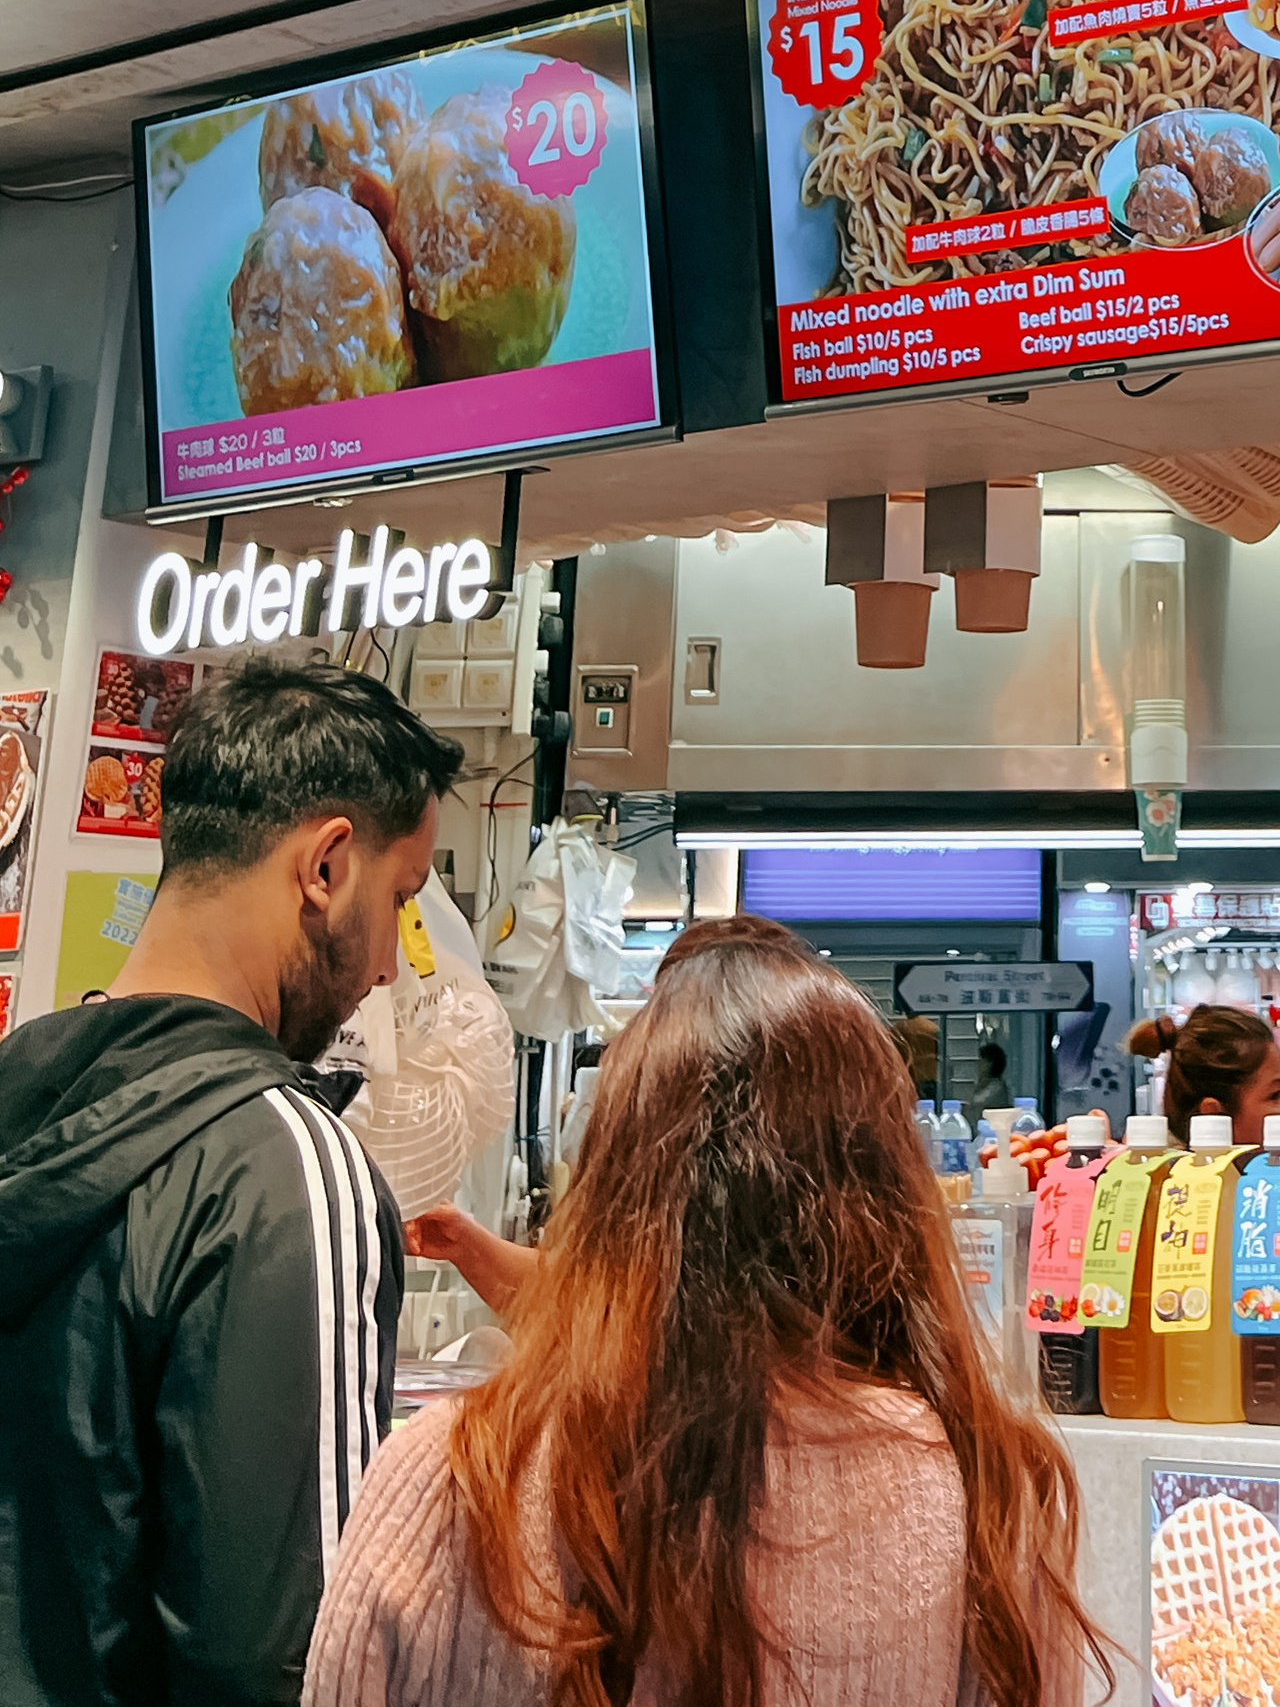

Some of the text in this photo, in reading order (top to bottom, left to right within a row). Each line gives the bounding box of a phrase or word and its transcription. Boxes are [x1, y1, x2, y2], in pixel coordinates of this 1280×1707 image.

[780, 12, 865, 86] $15
[511, 91, 597, 167] $20
[790, 267, 1126, 333] Mixed noodle with extra Dim Sum
[1018, 294, 1180, 331] Beef ball $15/2 pcs
[792, 327, 934, 361] Fish ball $10/5 pcs
[1020, 333, 1074, 356] Crispy
[794, 346, 981, 386] Fish dumpling $10/5 pcs
[218, 433, 249, 454] $20
[236, 450, 265, 473] Beef
[266, 447, 292, 468] ball
[295, 443, 318, 464] $20
[330, 439, 362, 460] 3pcs
[137, 523, 492, 656] Order Here
[1237, 1178, 1274, 1259] 消脂
